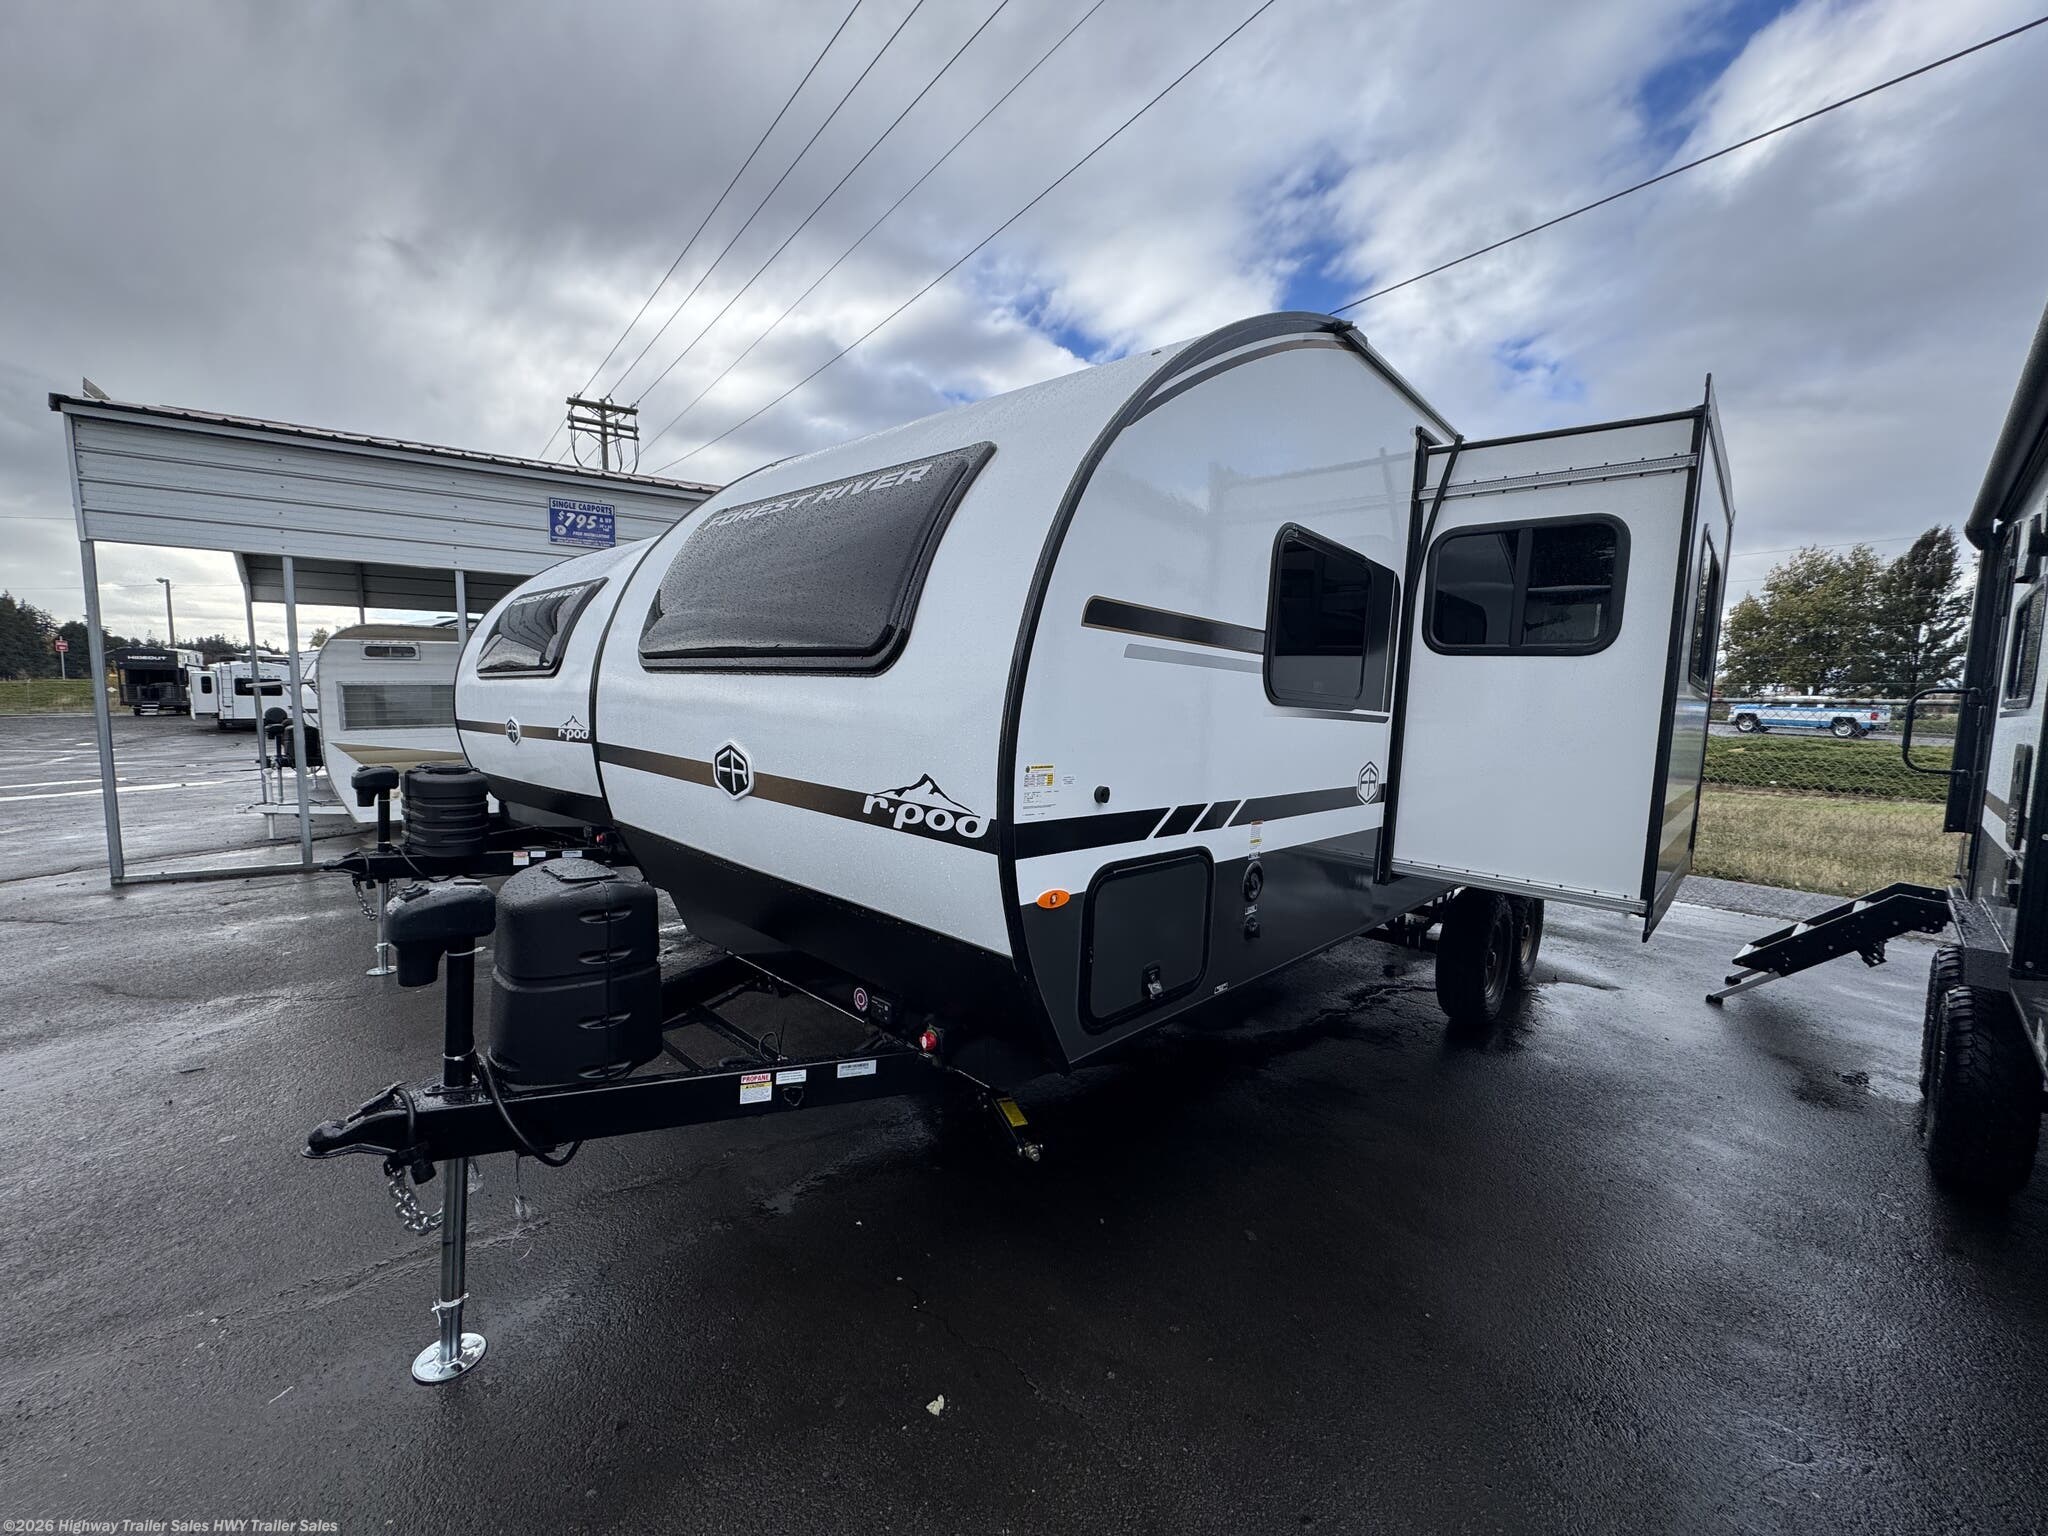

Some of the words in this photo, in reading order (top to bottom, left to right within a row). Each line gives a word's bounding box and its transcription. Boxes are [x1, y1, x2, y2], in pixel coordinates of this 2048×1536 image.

[703, 493, 815, 530] FOREST
[812, 464, 932, 503] RIVER
[551, 500, 576, 510] SINGLE
[578, 503, 613, 514] CARPORTS
[742, 1074, 770, 1082] PROPANE
